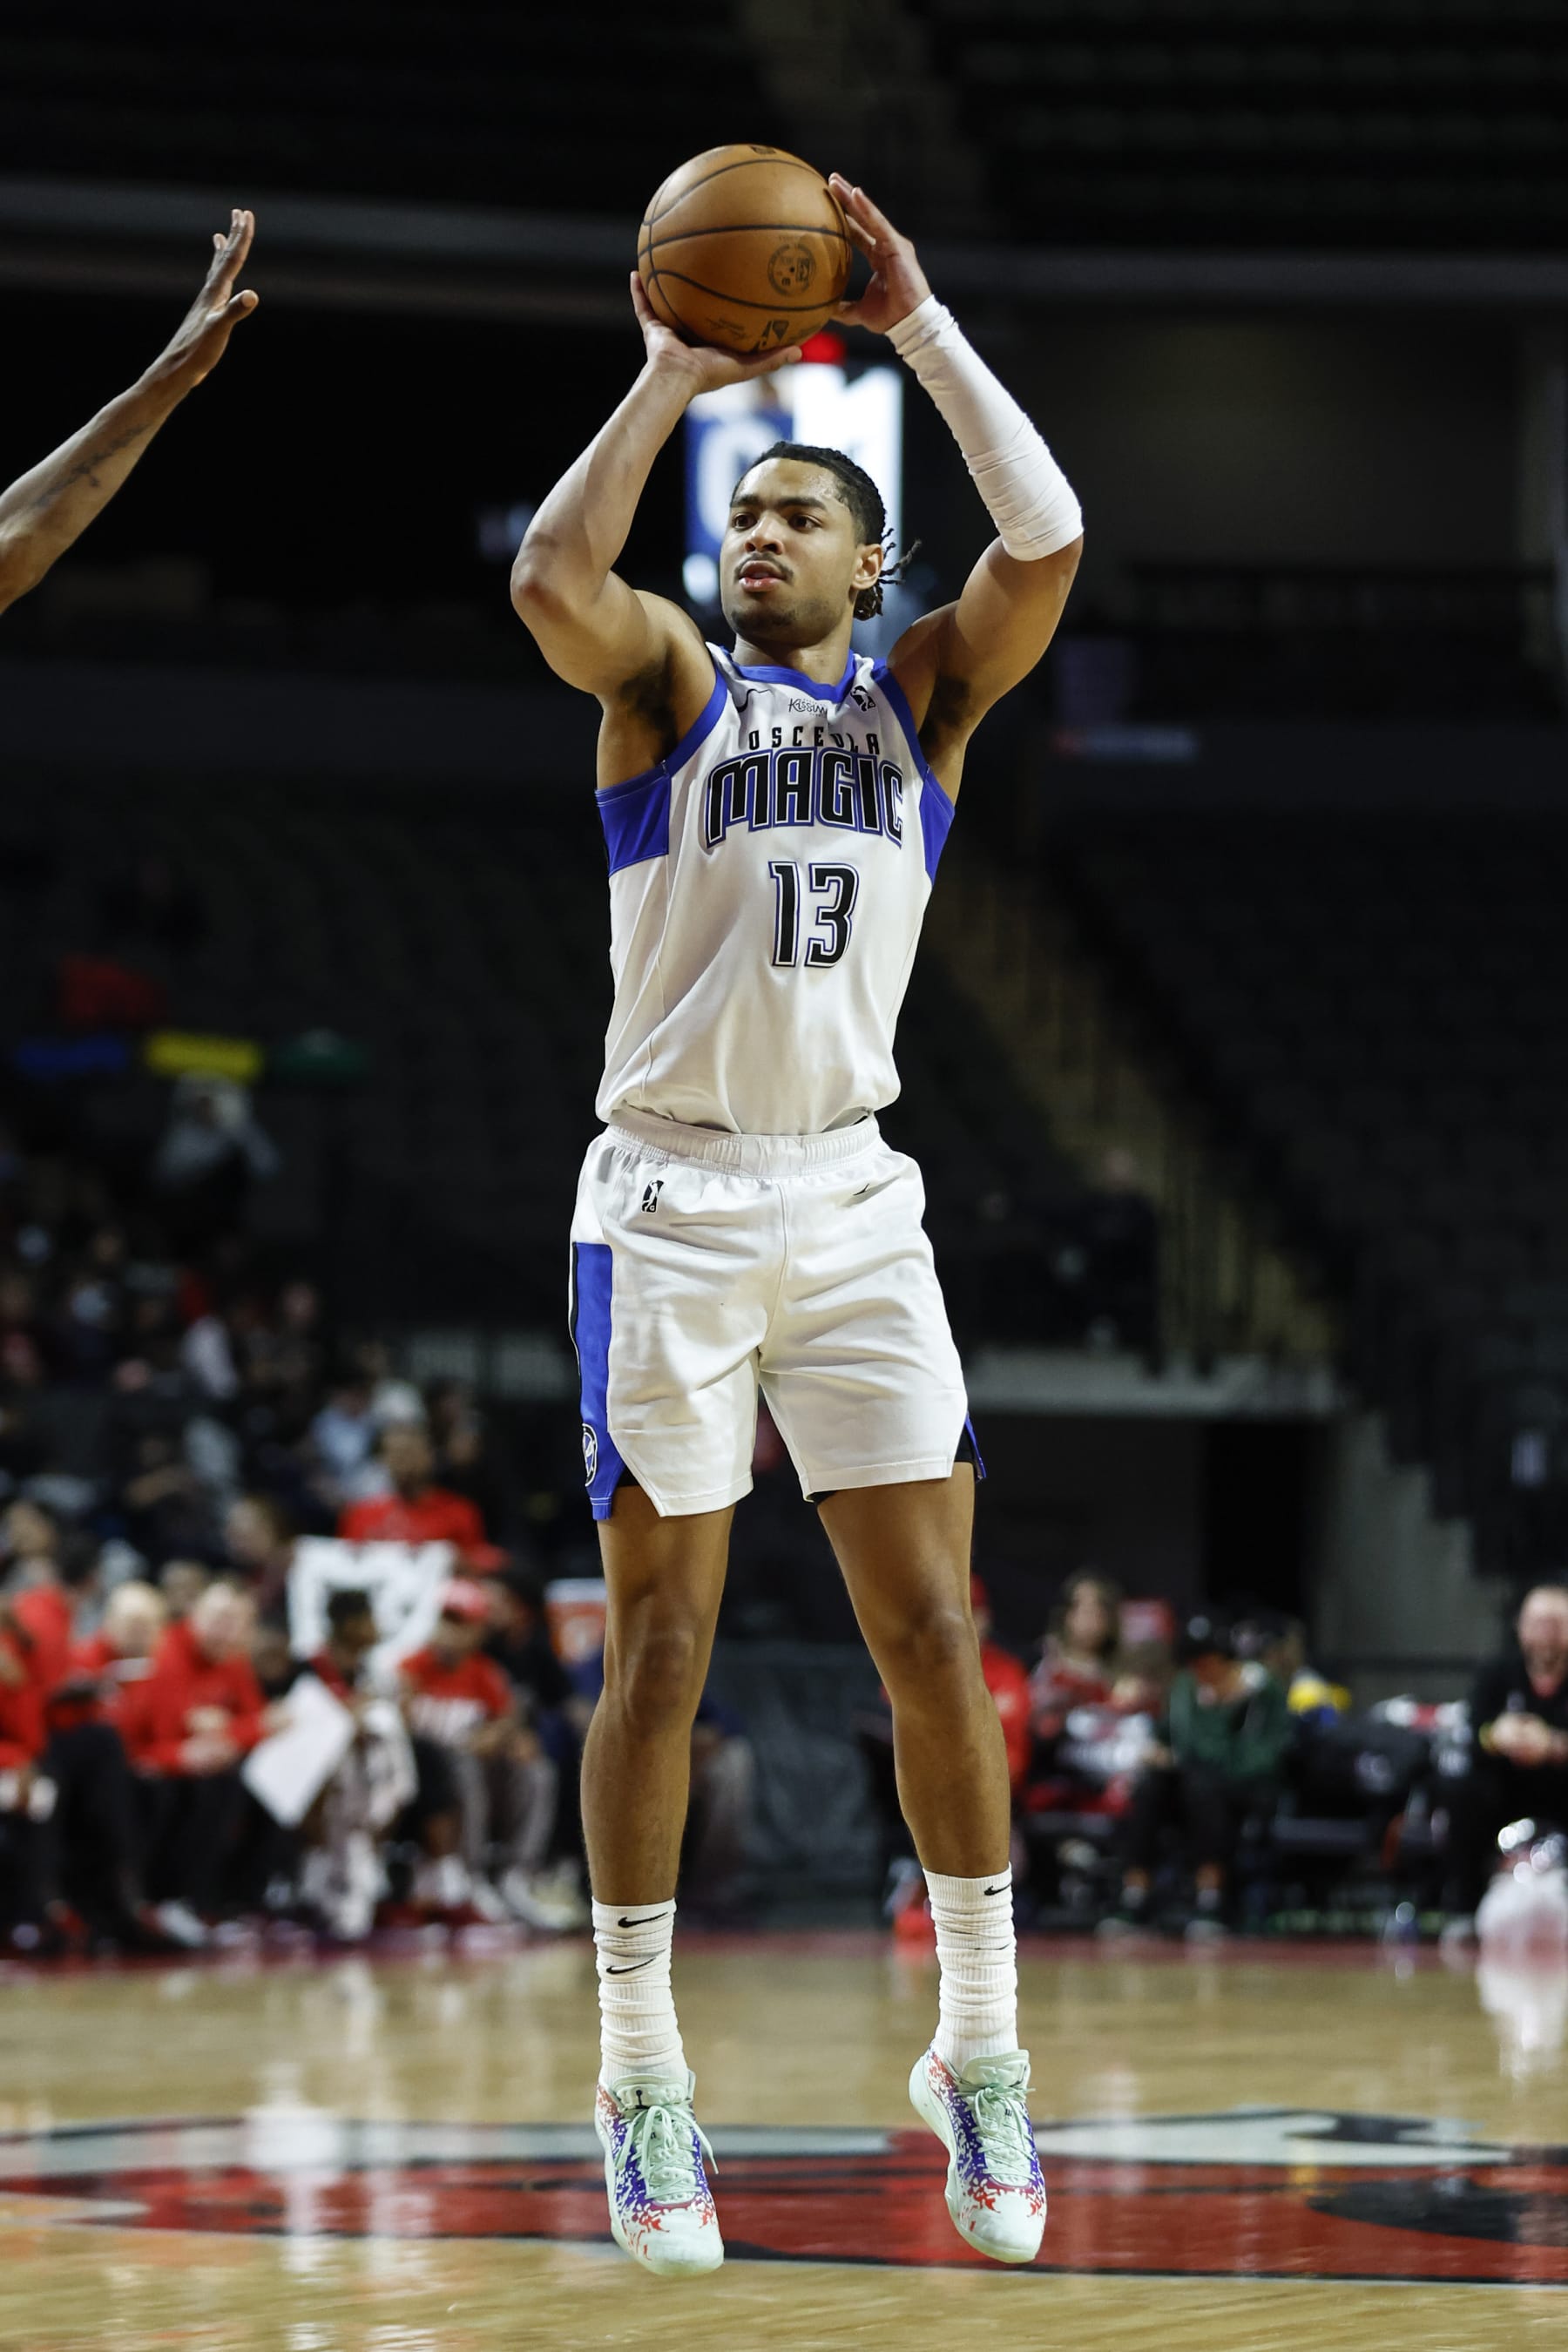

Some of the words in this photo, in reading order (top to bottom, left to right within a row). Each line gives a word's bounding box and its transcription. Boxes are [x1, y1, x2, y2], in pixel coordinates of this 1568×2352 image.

[748, 727, 880, 754] OSCEOLA
[705, 747, 903, 849] MAGIC
[768, 861, 859, 968] 13
